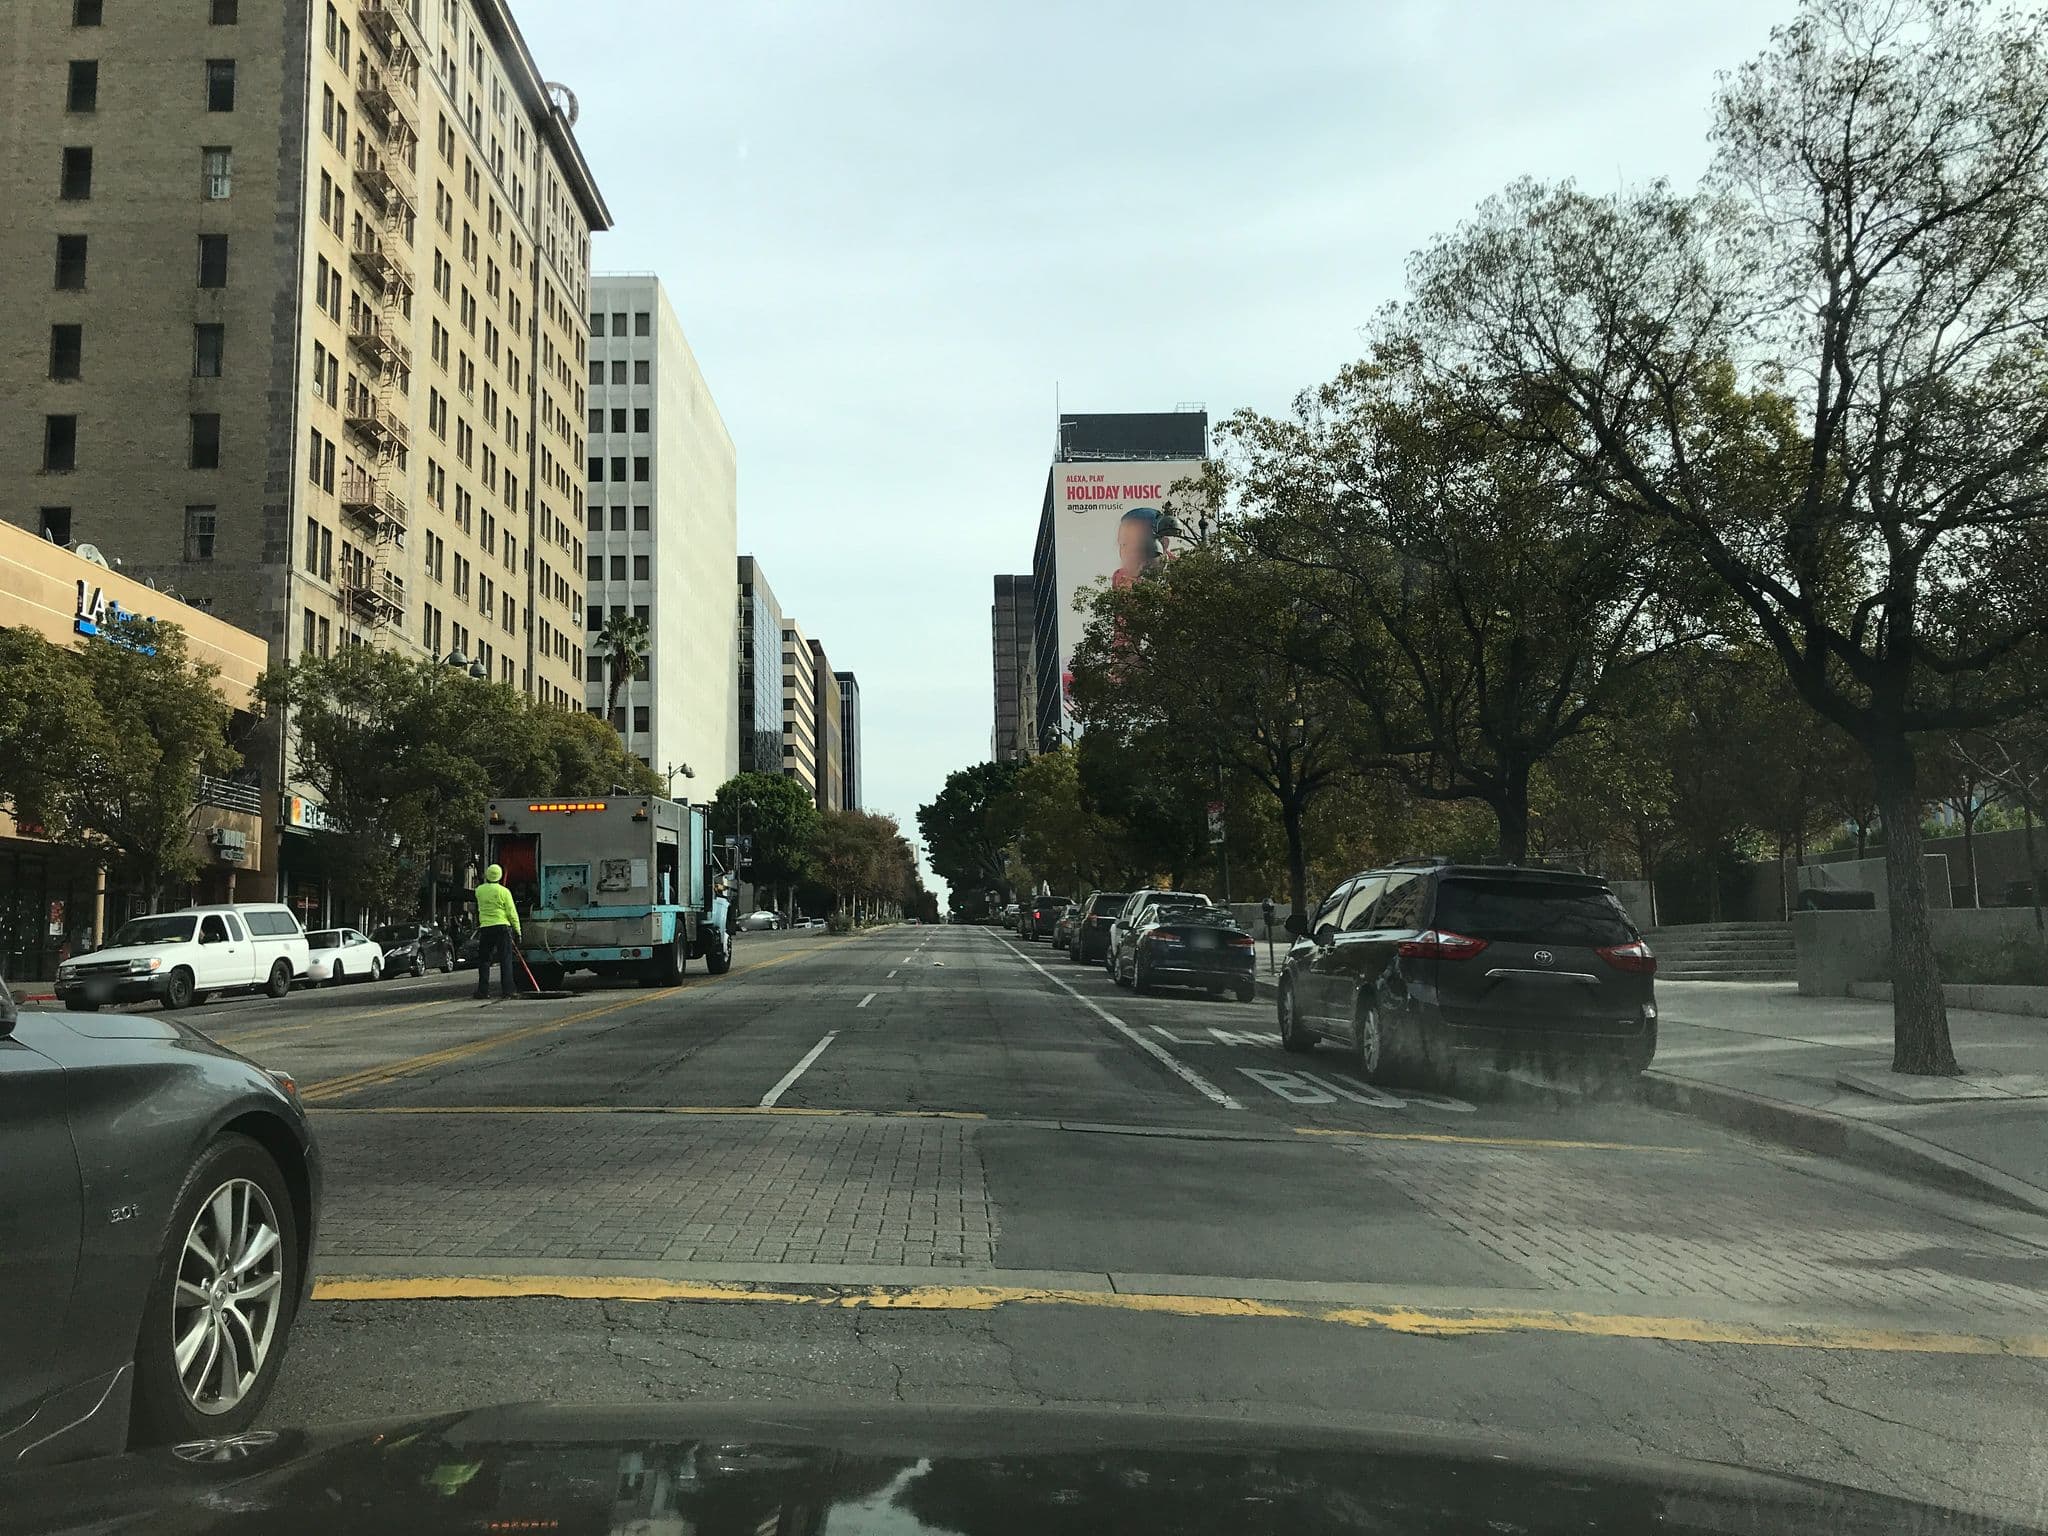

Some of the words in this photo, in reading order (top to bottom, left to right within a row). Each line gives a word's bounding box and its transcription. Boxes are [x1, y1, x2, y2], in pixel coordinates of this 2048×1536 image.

[1066, 475, 1088, 483] ALEXA,
[1067, 485, 1120, 500] HOLIDAY
[1123, 485, 1162, 499] MUSIC
[1067, 504, 1097, 512] amazon
[77, 580, 107, 624] LA
